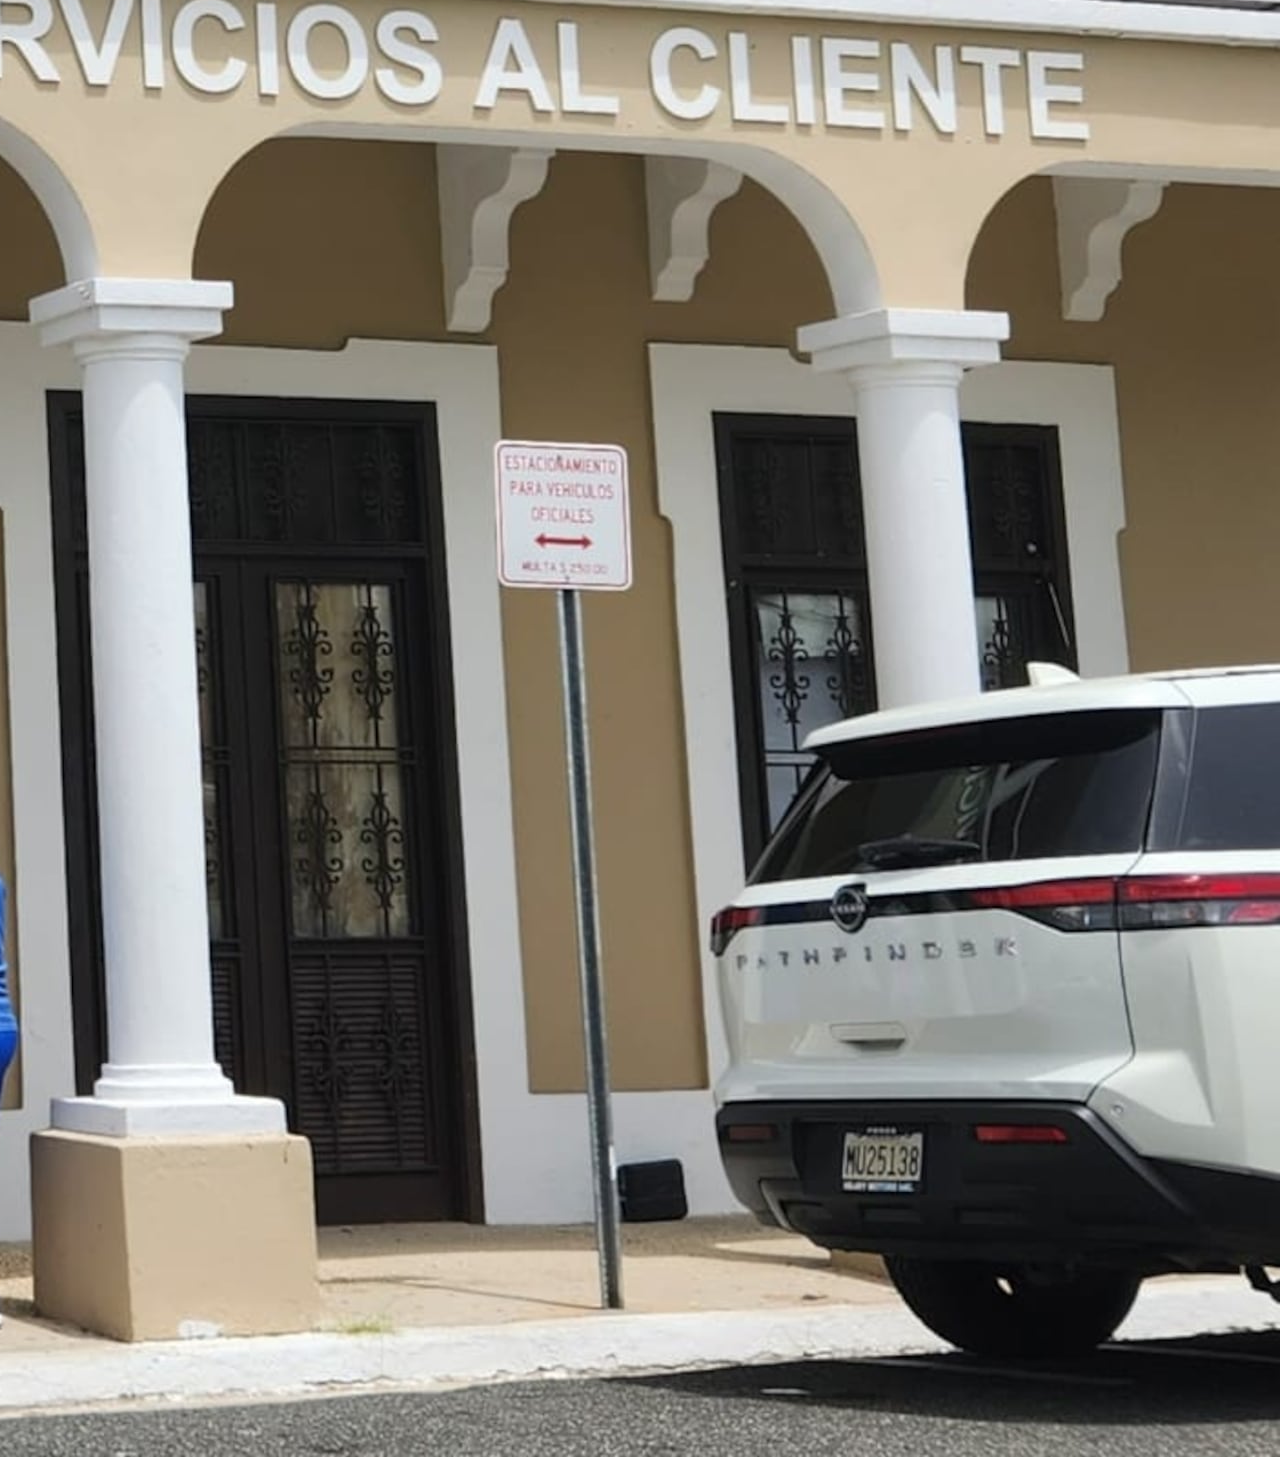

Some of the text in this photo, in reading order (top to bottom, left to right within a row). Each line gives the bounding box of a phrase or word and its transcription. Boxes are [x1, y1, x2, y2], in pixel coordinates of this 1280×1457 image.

[472, 17, 620, 116] AL
[649, 27, 1090, 142] CLIENTE
[504, 455, 617, 474] ESTACIONAMIENTO
[509, 480, 614, 499] PARA VEHICULOS
[531, 507, 594, 524] OFICIALES
[522, 559, 557, 571] MULTA
[844, 1144, 920, 1176] MU25138
